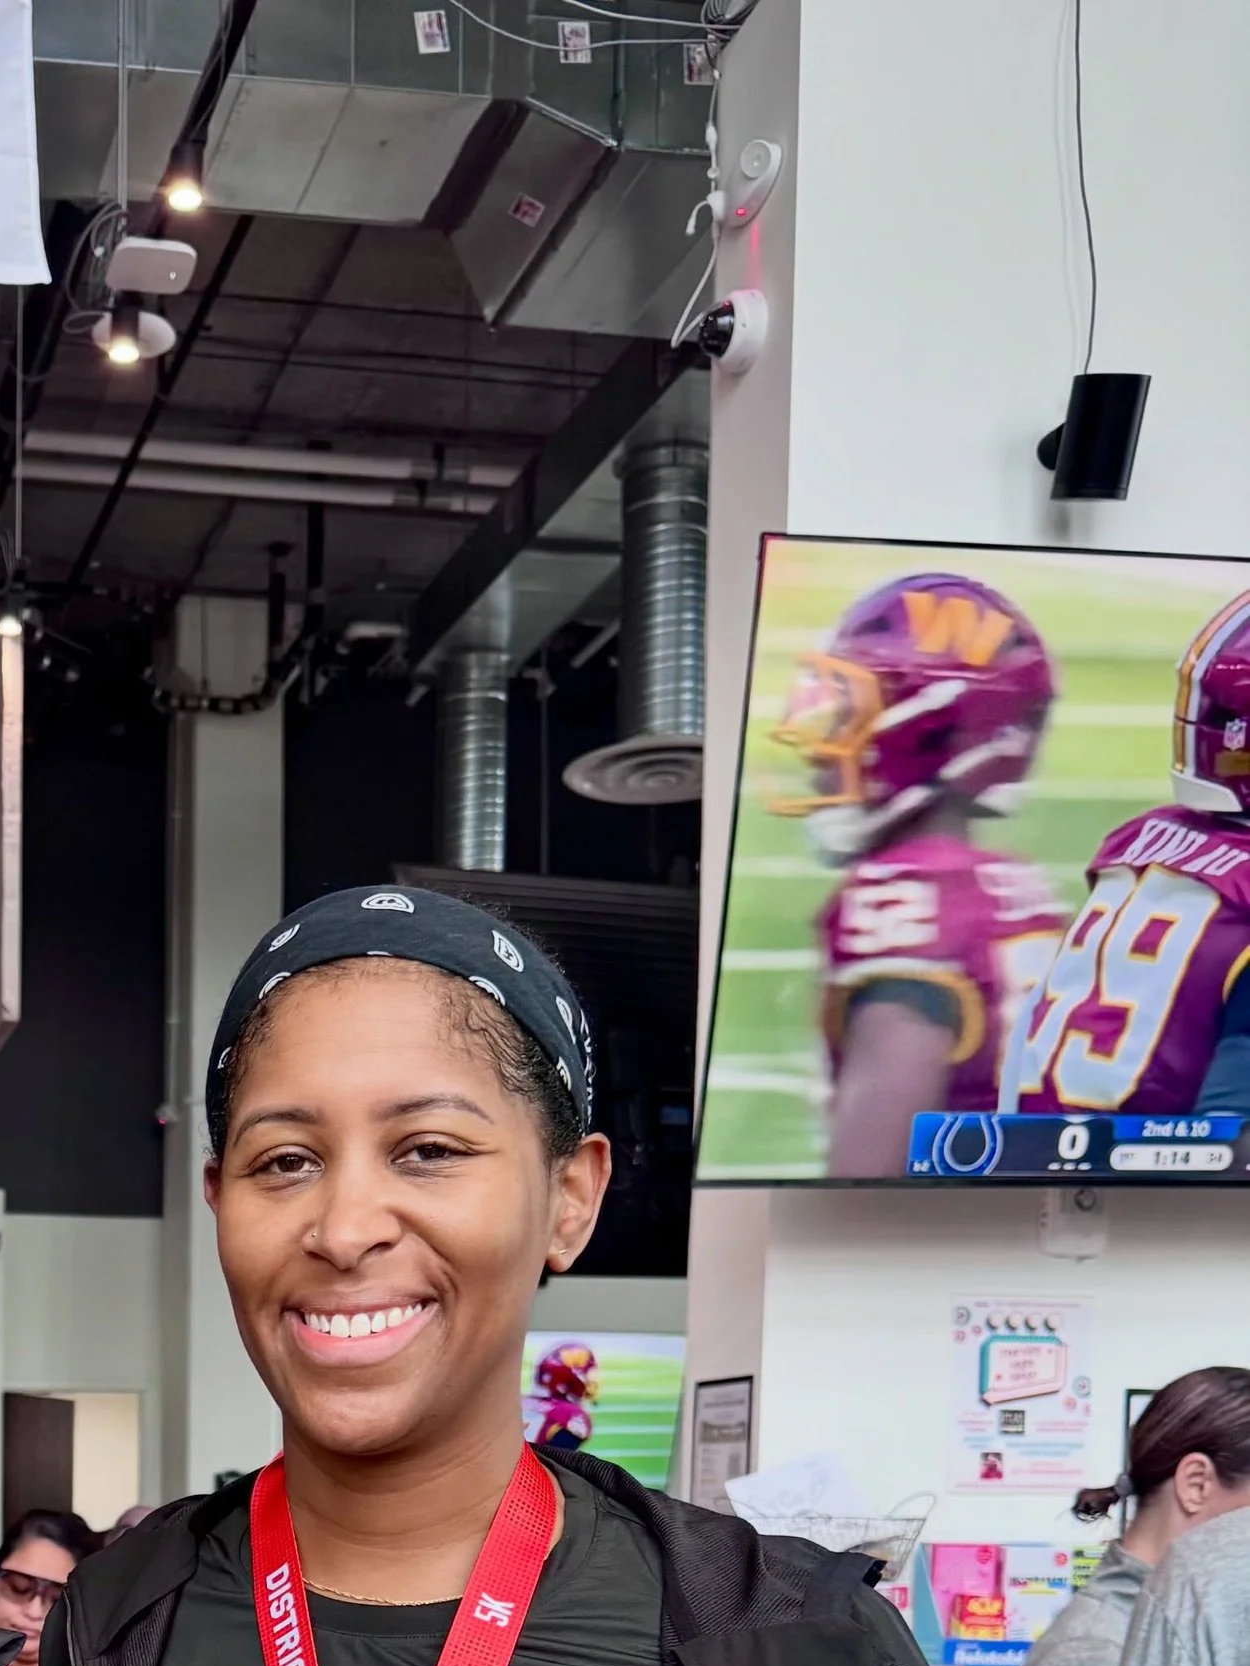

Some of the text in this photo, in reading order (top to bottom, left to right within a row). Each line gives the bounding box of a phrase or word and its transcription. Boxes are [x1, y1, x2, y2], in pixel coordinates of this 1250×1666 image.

[1058, 1125, 1090, 1160] 0
[1142, 1120, 1211, 1138] 2nd & 10
[473, 1591, 516, 1628] 5K
